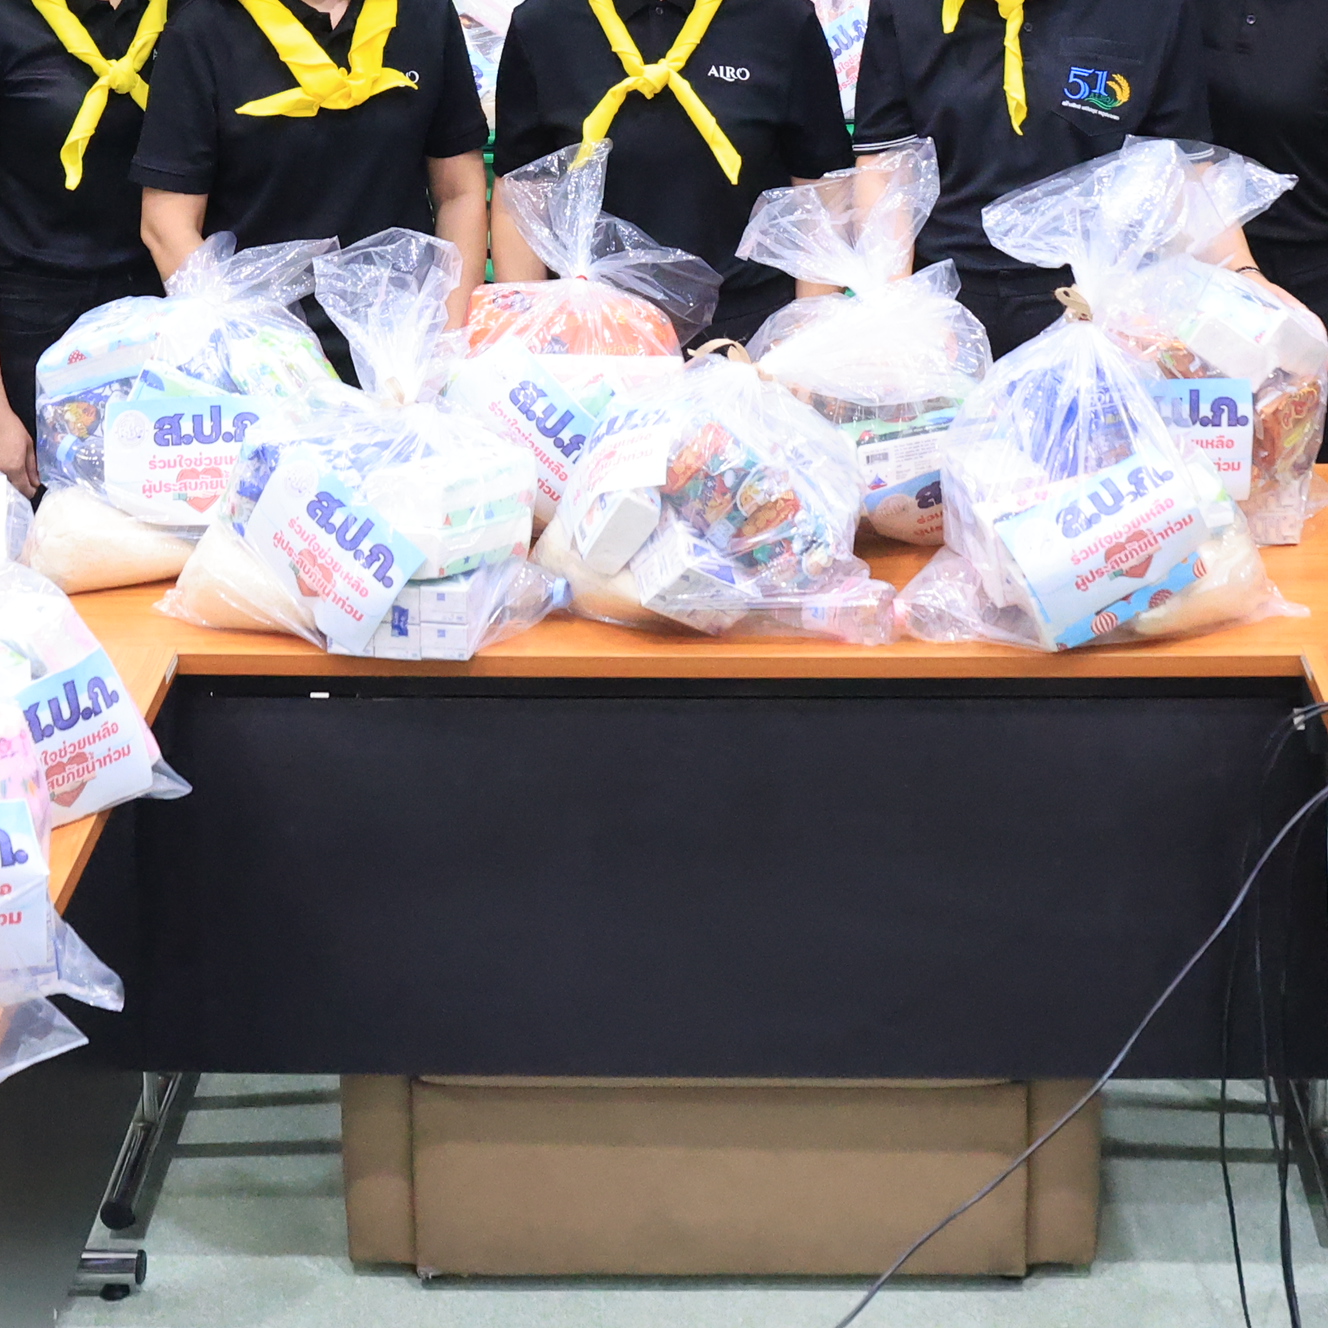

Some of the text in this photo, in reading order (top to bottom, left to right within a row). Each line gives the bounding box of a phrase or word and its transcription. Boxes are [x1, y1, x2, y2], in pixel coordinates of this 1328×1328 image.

[707, 64, 751, 82] ALRO
[1063, 66, 1108, 100] 51
[306, 491, 395, 589] ส.ป.ก.
[1055, 465, 1175, 539] ส.ป.ก.
[273, 529, 365, 622] ผู้ประสบภัยน้ำท่วม
[287, 516, 370, 599] ร่วมใจช่วยเหลือ
[1075, 514, 1195, 592] ผู้ประสบภัยน้ำท่วม
